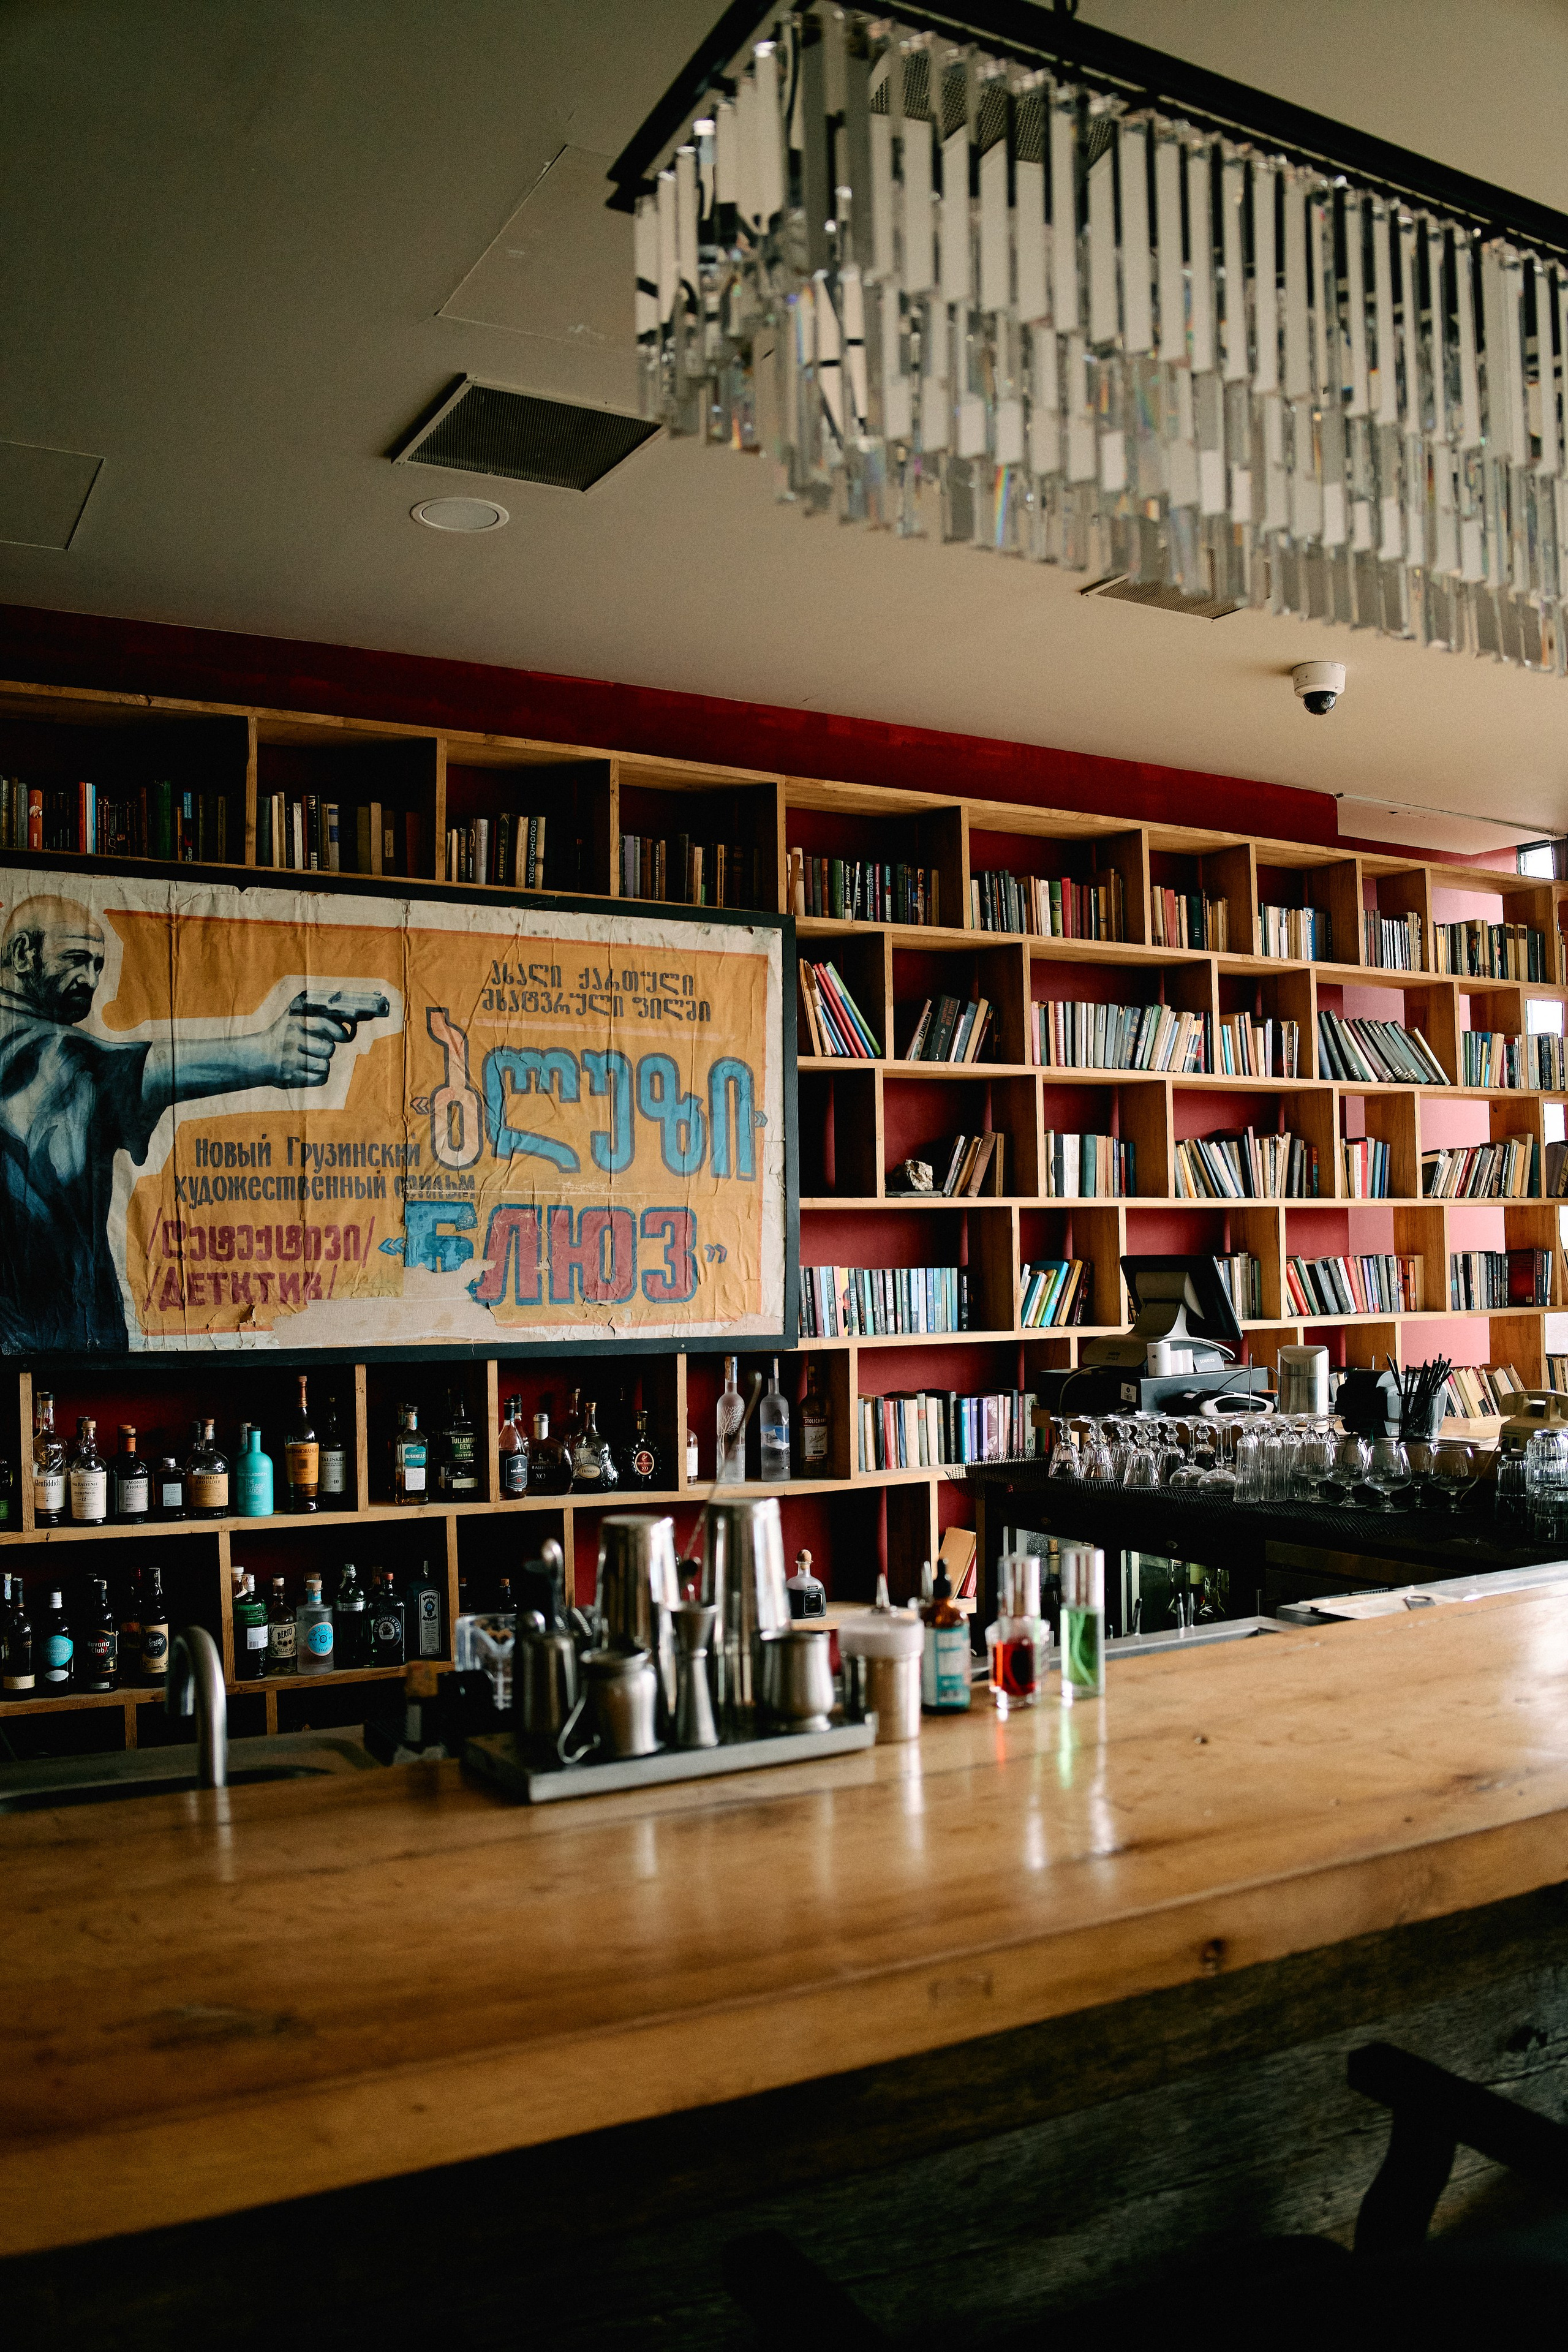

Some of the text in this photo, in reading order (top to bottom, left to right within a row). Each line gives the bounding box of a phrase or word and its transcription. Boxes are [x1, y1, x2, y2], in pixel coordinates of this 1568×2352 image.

[529, 820, 537, 883] ТОВСТОНОГОВ
[491, 960, 693, 997] ახალი ქართული
[482, 989, 712, 1022] მხატვრული ფილმი
[195, 1134, 271, 1168] Новый
[34, 1479, 61, 1488] Glenfiddich
[374, 1616, 396, 1634] PLYMOUTH
